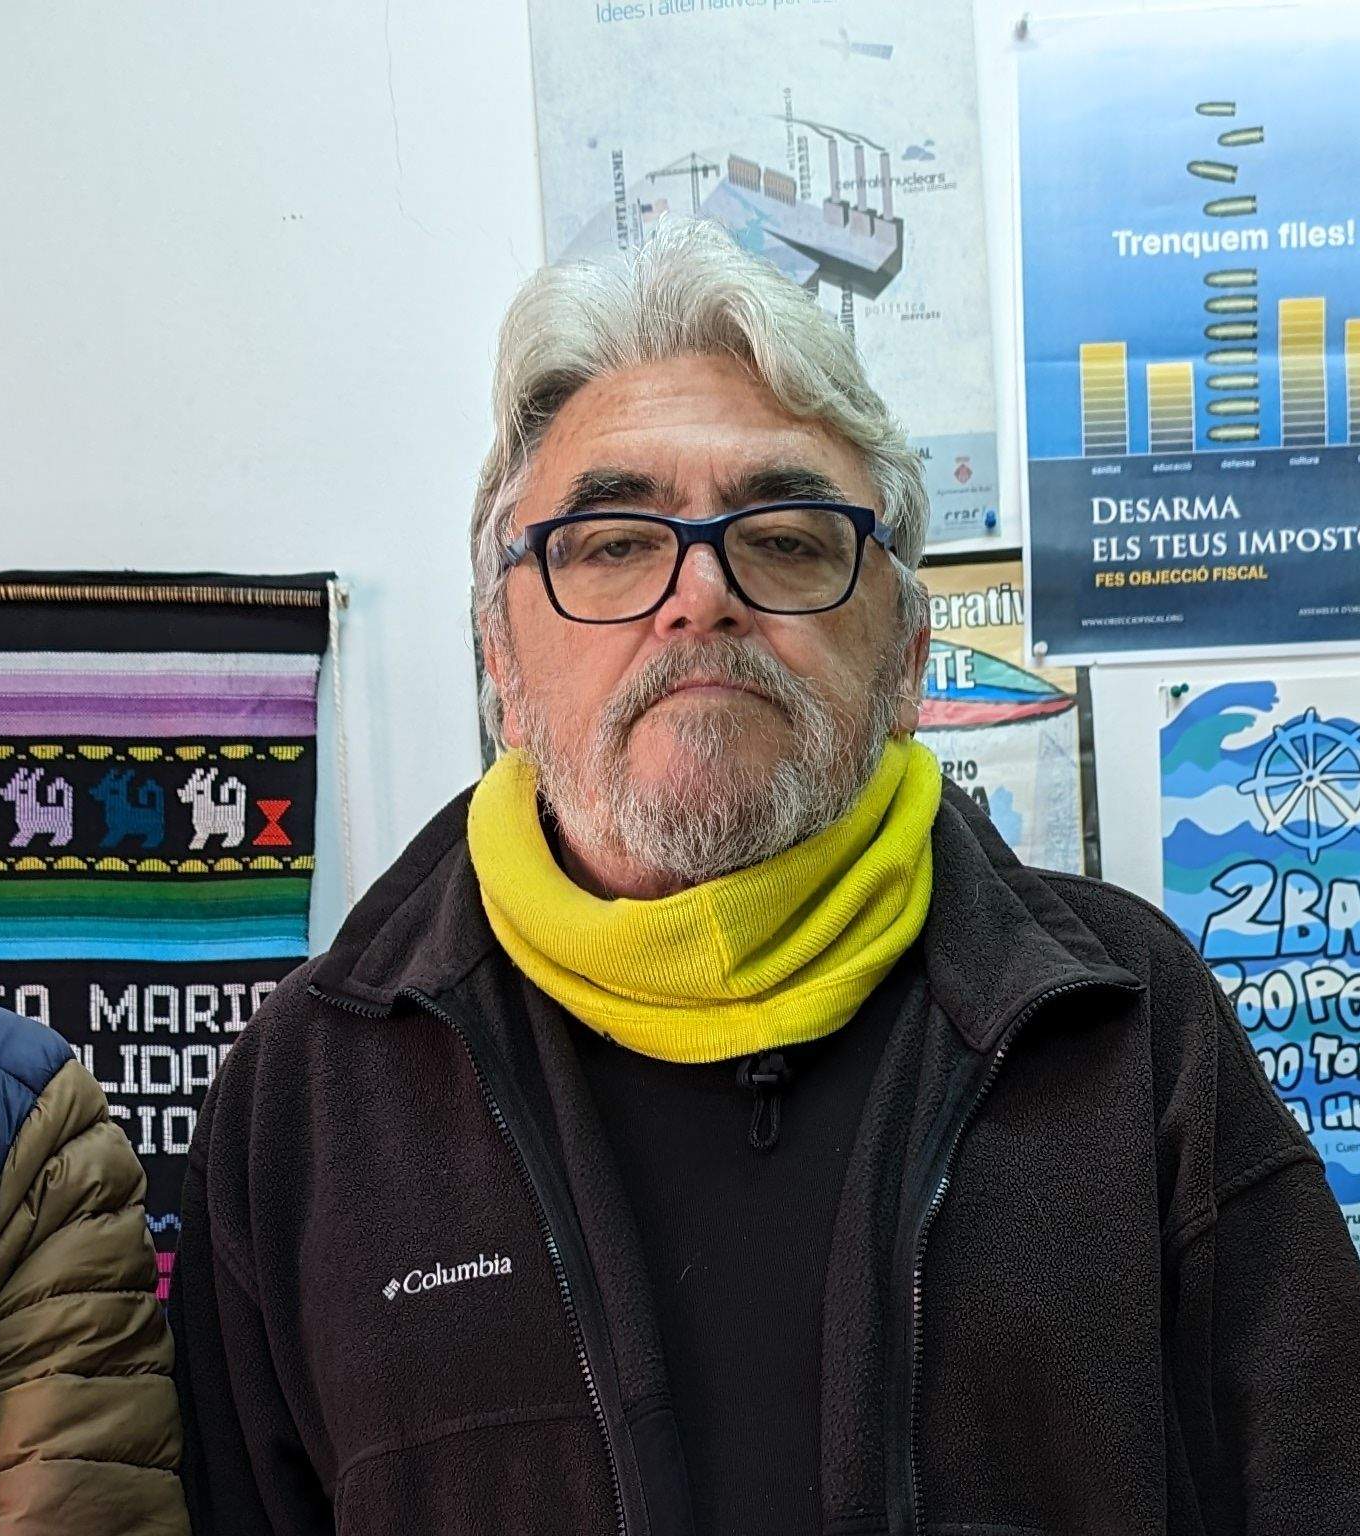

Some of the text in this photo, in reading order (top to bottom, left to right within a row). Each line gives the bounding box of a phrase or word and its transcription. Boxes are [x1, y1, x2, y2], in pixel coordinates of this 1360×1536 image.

[1112, 219, 1356, 259] Trenquem files!
[1092, 535, 1142, 563] ELS
[1149, 530, 1228, 560] TEUS
[1094, 563, 1268, 588] FES OBJECCIÓ FISCAL
[402, 1253, 513, 1295] Columbia
